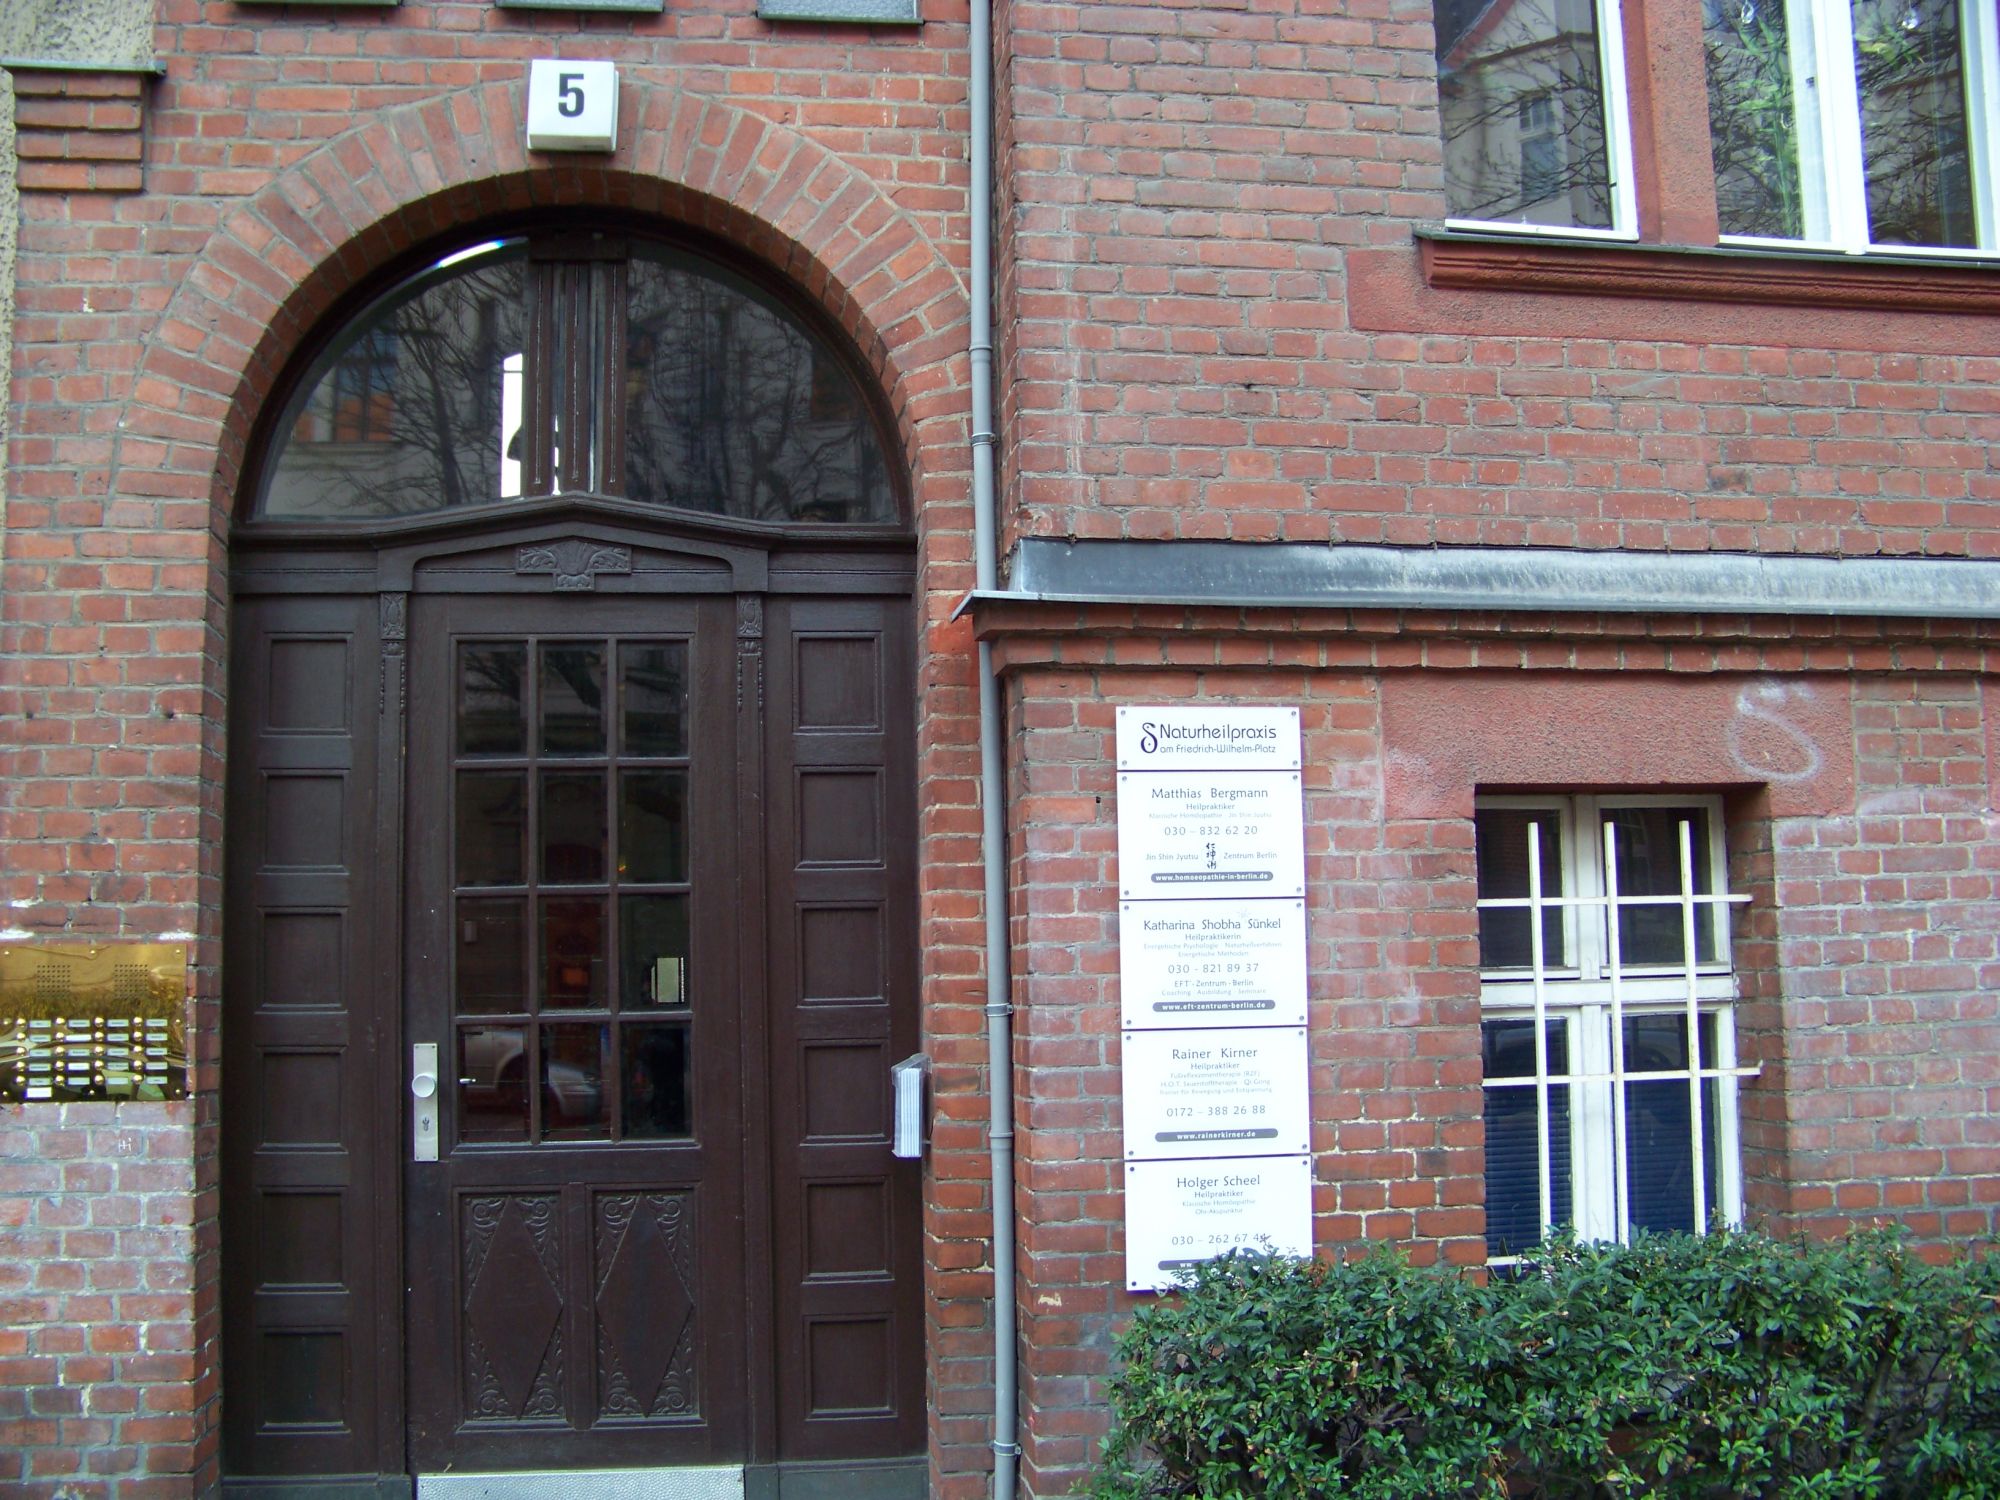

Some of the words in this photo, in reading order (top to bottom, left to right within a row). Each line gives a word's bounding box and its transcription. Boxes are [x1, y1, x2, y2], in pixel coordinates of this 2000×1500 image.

[558, 73, 585, 118] 5
[1160, 723, 1277, 743] Naturheilpraxis
[1160, 746, 1174, 754] am
[1176, 744, 1277, 754] Friedrich-Wilhelm-Platz
[1151, 788, 1202, 799] Matthias
[1210, 787, 1269, 801] Bergmann
[1185, 803, 1236, 812] Heilpraktiker
[1164, 826, 1186, 836] 030
[1199, 826, 1220, 836] 832
[1225, 826, 1239, 835] 62
[1244, 825, 1258, 835] 20
[1145, 853, 1157, 861] Jin
[1158, 852, 1174, 861] Shin
[1176, 852, 1199, 862] Jyutsu
[1223, 852, 1254, 860] Zentrum
[1156, 873, 1268, 882] www.homoeopathie-in-berlin.de
[1143, 919, 1195, 931] Katharina
[1202, 919, 1241, 930] Shobha
[1247, 918, 1282, 929] Sünkel
[1185, 933, 1242, 942] Heilpraktikerin
[1168, 964, 1190, 974] 030
[1202, 964, 1222, 973] 821
[1226, 964, 1241, 973] 89
[1246, 963, 1259, 972] 37
[1163, 1002, 1266, 1010] www.eft-zentrum-berlin.de
[1172, 1048, 1212, 1060] Rainer
[1221, 1048, 1258, 1059] Kirner
[1190, 1062, 1240, 1071] Heilpraktiker
[1166, 1108, 1193, 1118] 0172
[1208, 1106, 1228, 1116] 388
[1233, 1105, 1247, 1115] 26
[1252, 1105, 1266, 1114] 88
[1177, 1131, 1256, 1139] www.rainerkirner.de
[1177, 1177, 1219, 1190] Holger
[1223, 1174, 1261, 1186] Scheel
[1194, 1190, 1244, 1200] Heilpraktiker
[1172, 1236, 1194, 1246] 030
[1208, 1234, 1229, 1244] 262
[1234, 1234, 1248, 1243] 67
